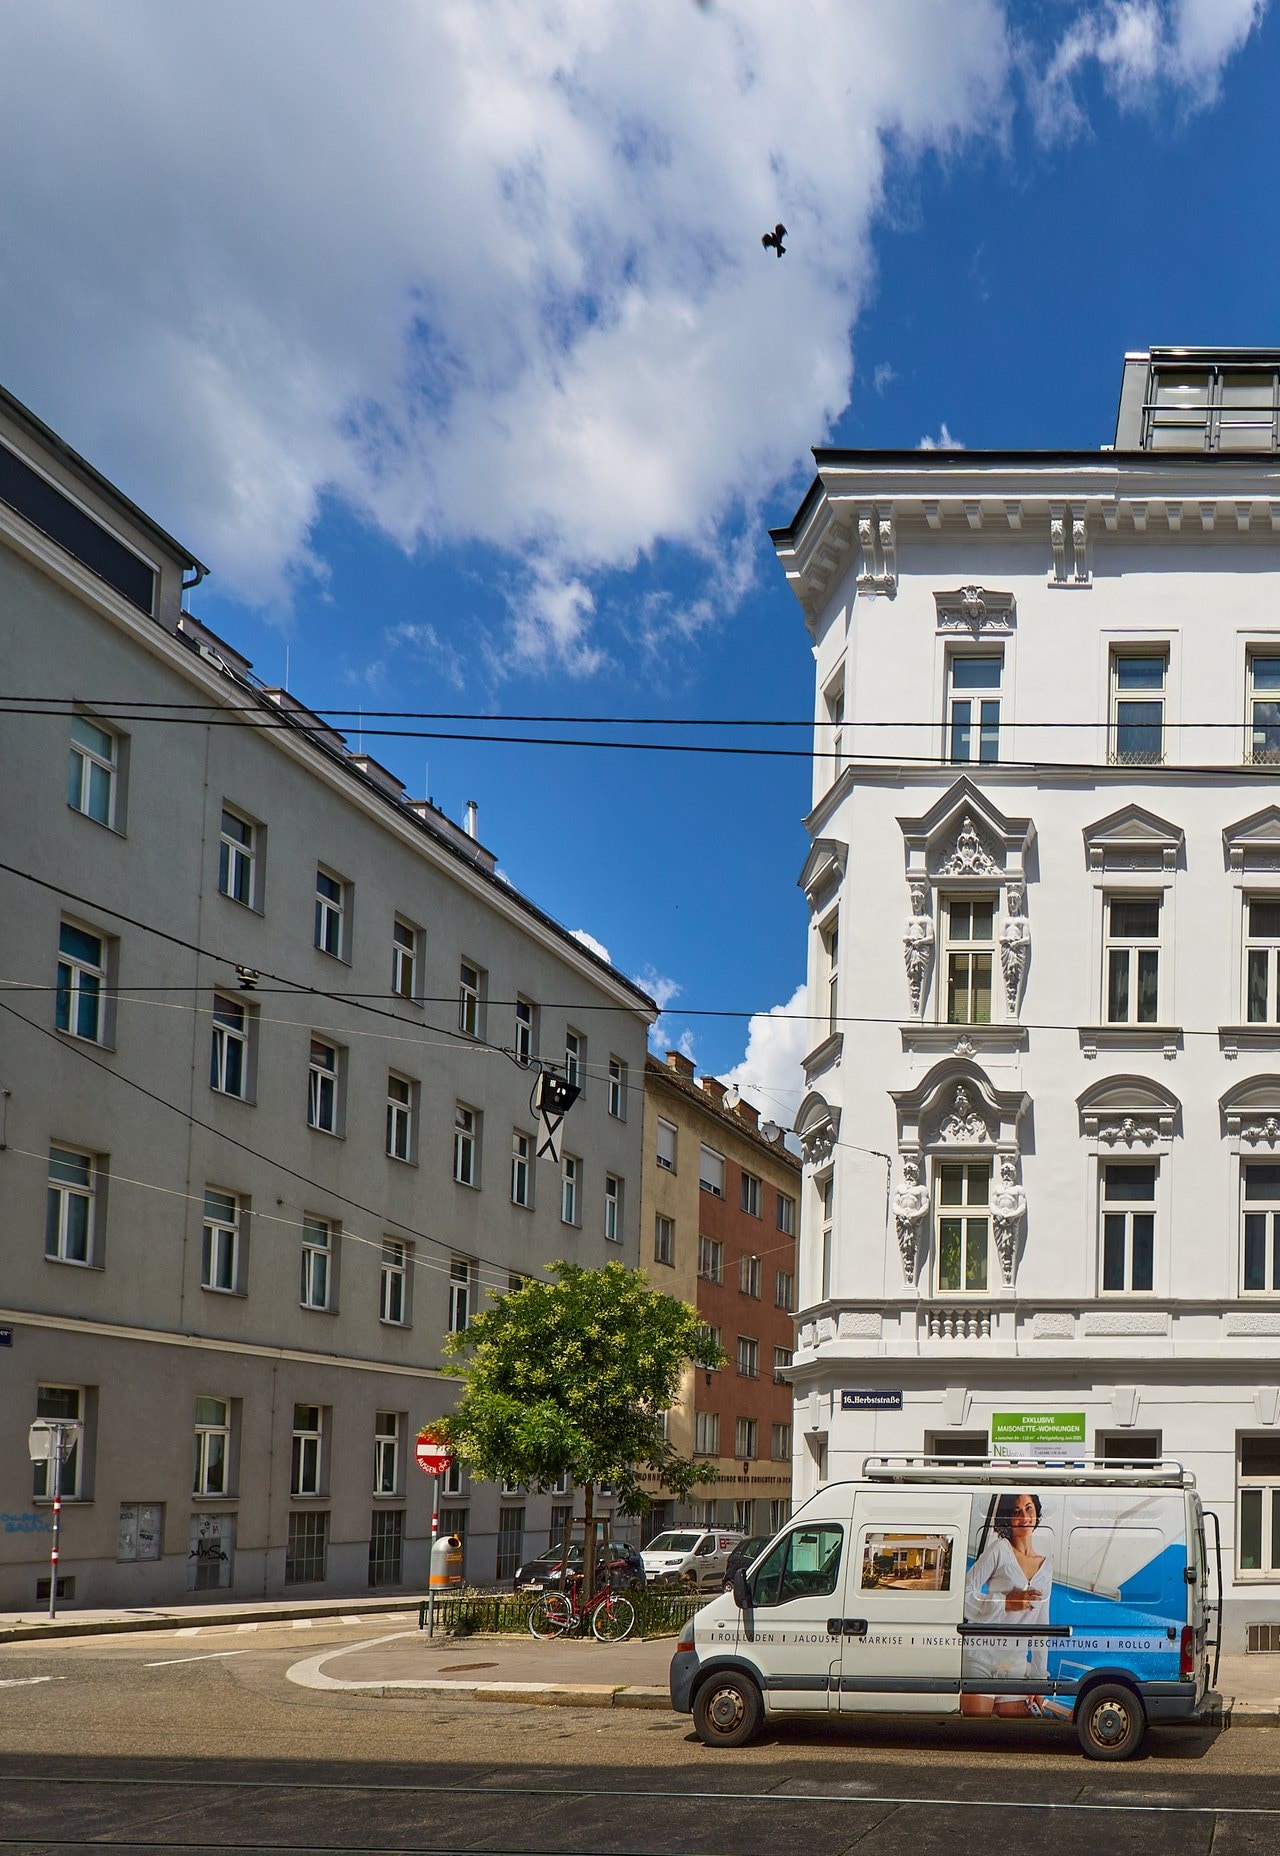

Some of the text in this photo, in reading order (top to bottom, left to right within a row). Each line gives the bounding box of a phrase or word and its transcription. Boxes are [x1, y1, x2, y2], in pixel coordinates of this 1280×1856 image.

[1022, 1416, 1055, 1424] EXKLUSIVE
[859, 1636, 903, 1645] MARKISE
[922, 1637, 1008, 1647] INSEKTENSCHUTZ
[1027, 1639, 1098, 1649] BESCHATTUNG
[1118, 1640, 1151, 1650] ROLLO
